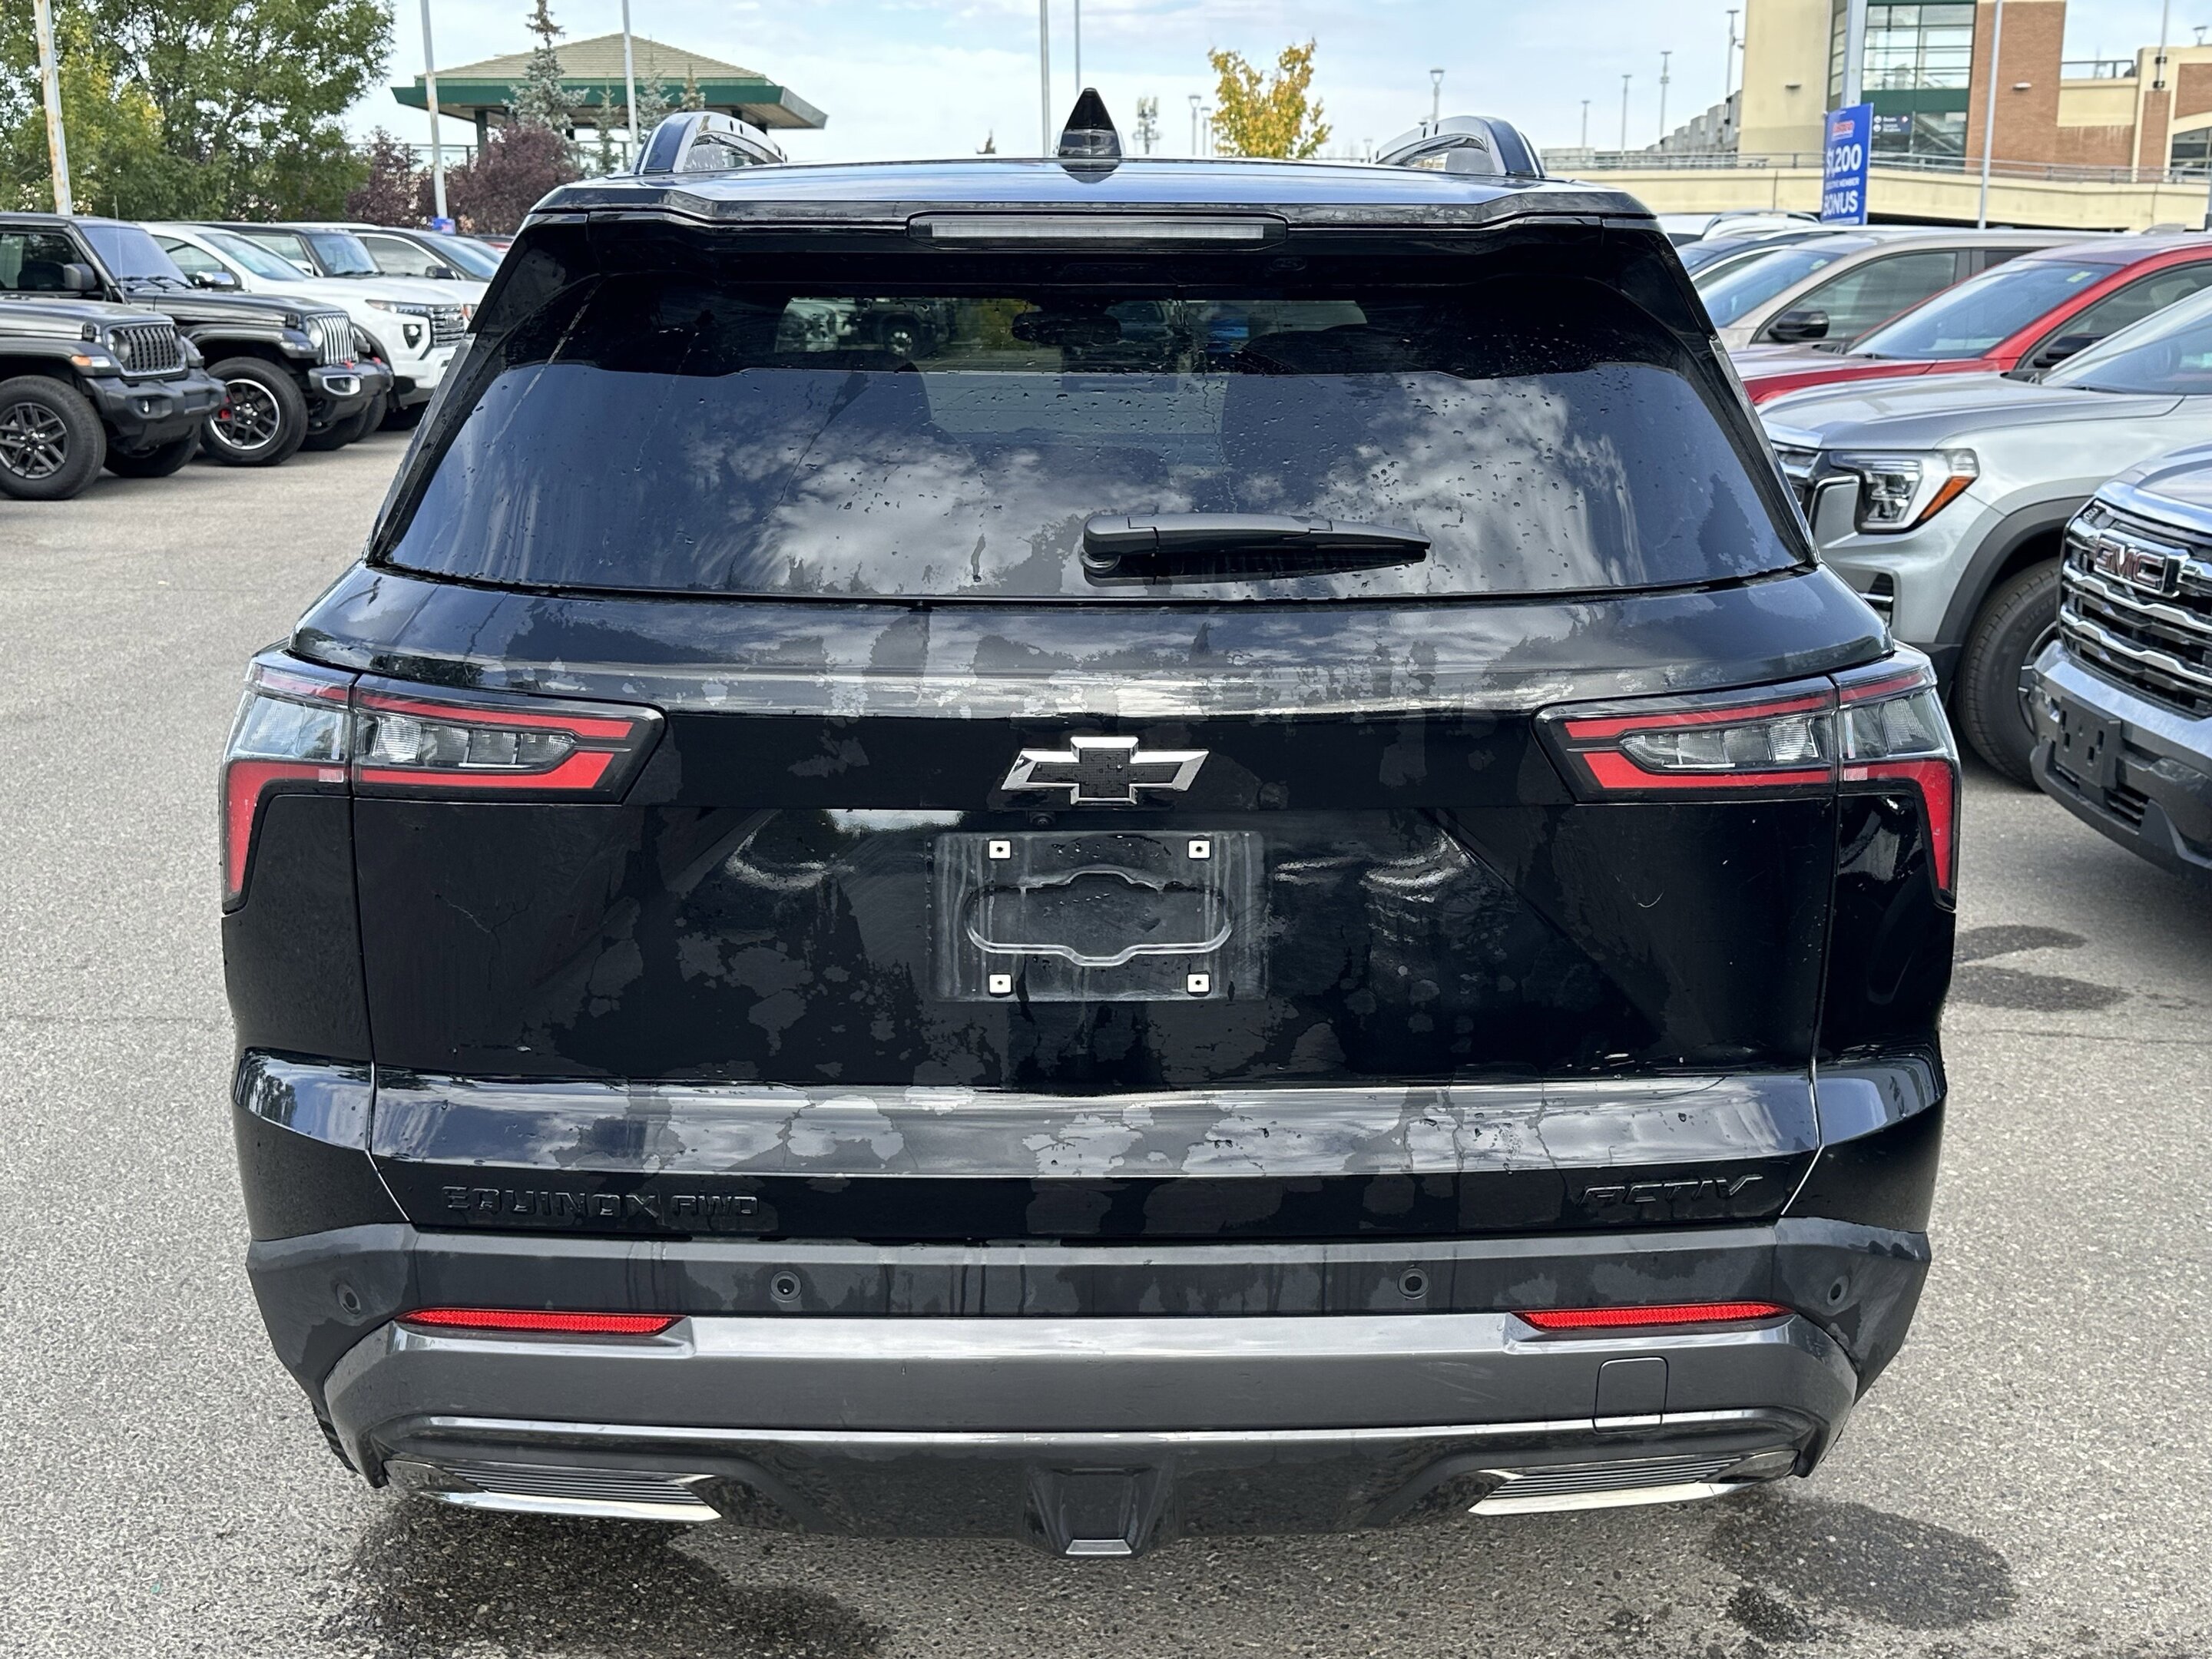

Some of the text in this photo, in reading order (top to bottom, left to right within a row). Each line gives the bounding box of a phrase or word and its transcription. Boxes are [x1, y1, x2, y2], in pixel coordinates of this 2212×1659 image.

[1823, 190, 1859, 217] BONUS
[2094, 538, 2164, 589] GMC
[441, 1185, 760, 1219] EQUINOX AWD
